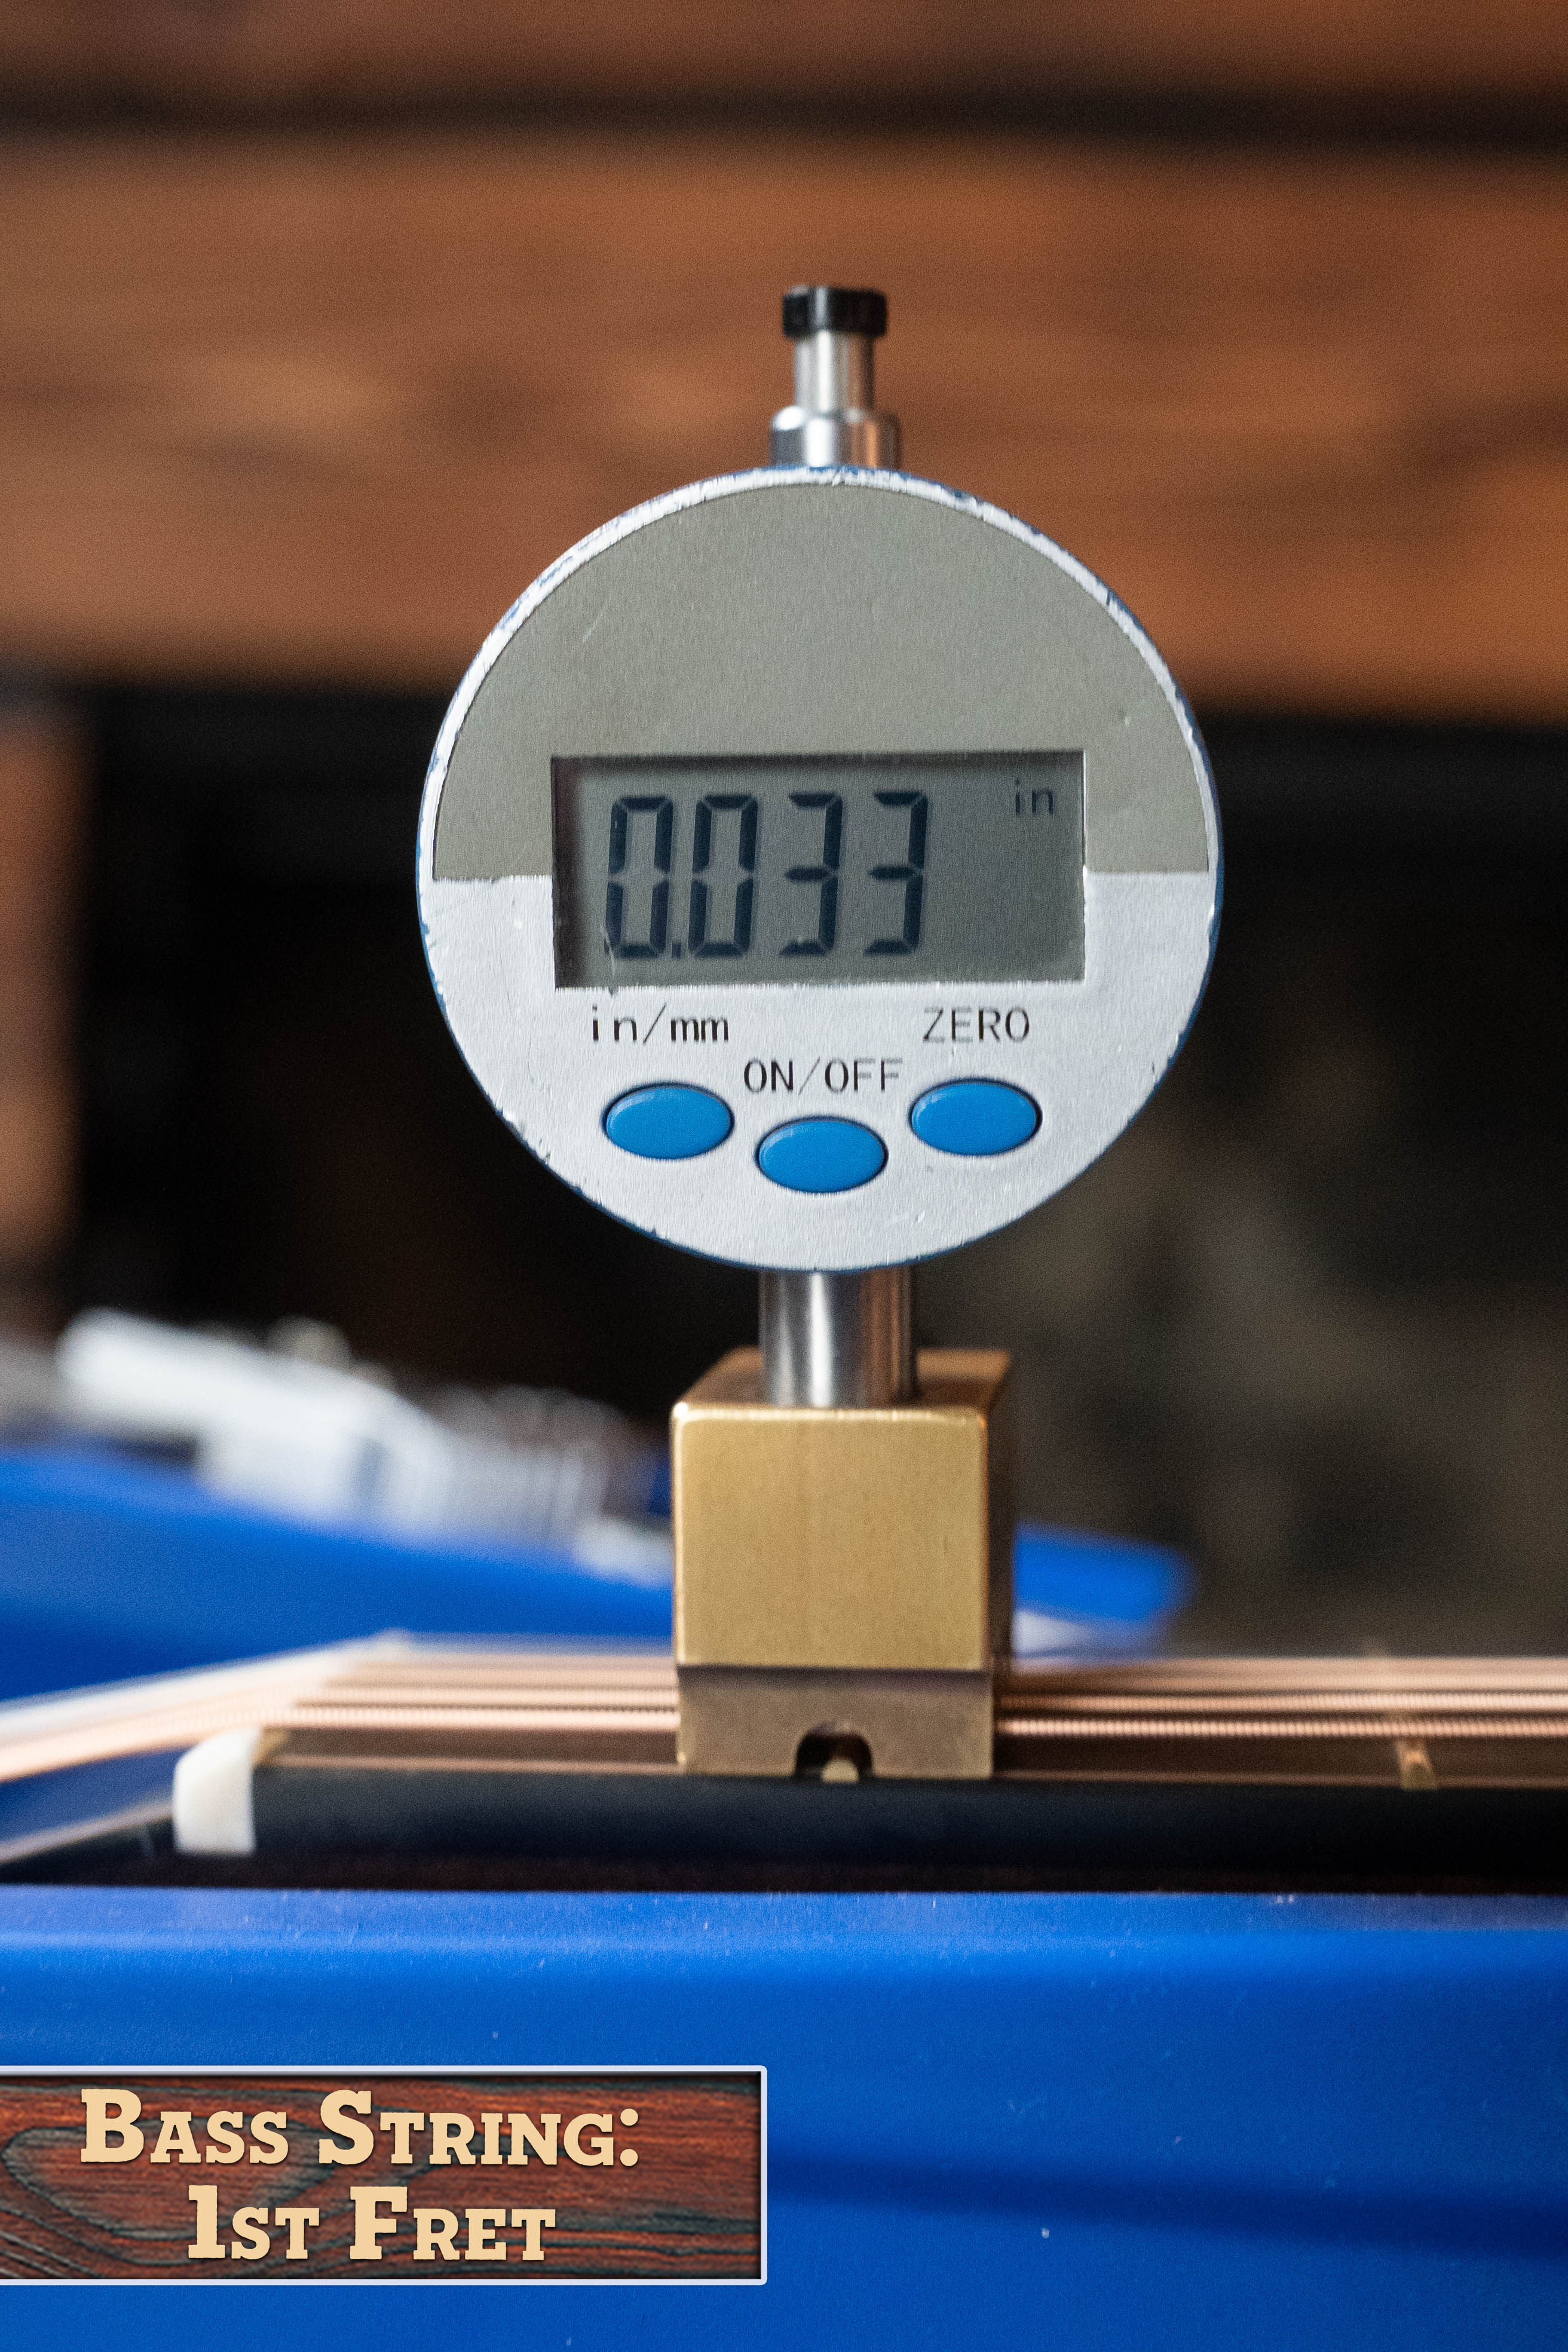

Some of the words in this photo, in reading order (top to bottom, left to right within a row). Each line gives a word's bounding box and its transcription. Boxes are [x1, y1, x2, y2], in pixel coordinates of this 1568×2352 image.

[1015, 779, 1055, 816] in
[604, 791, 929, 959] 0.033
[591, 1004, 730, 1045] in/mm
[923, 1006, 1030, 1043] ZERO
[743, 1057, 903, 1095] ON/OFF
